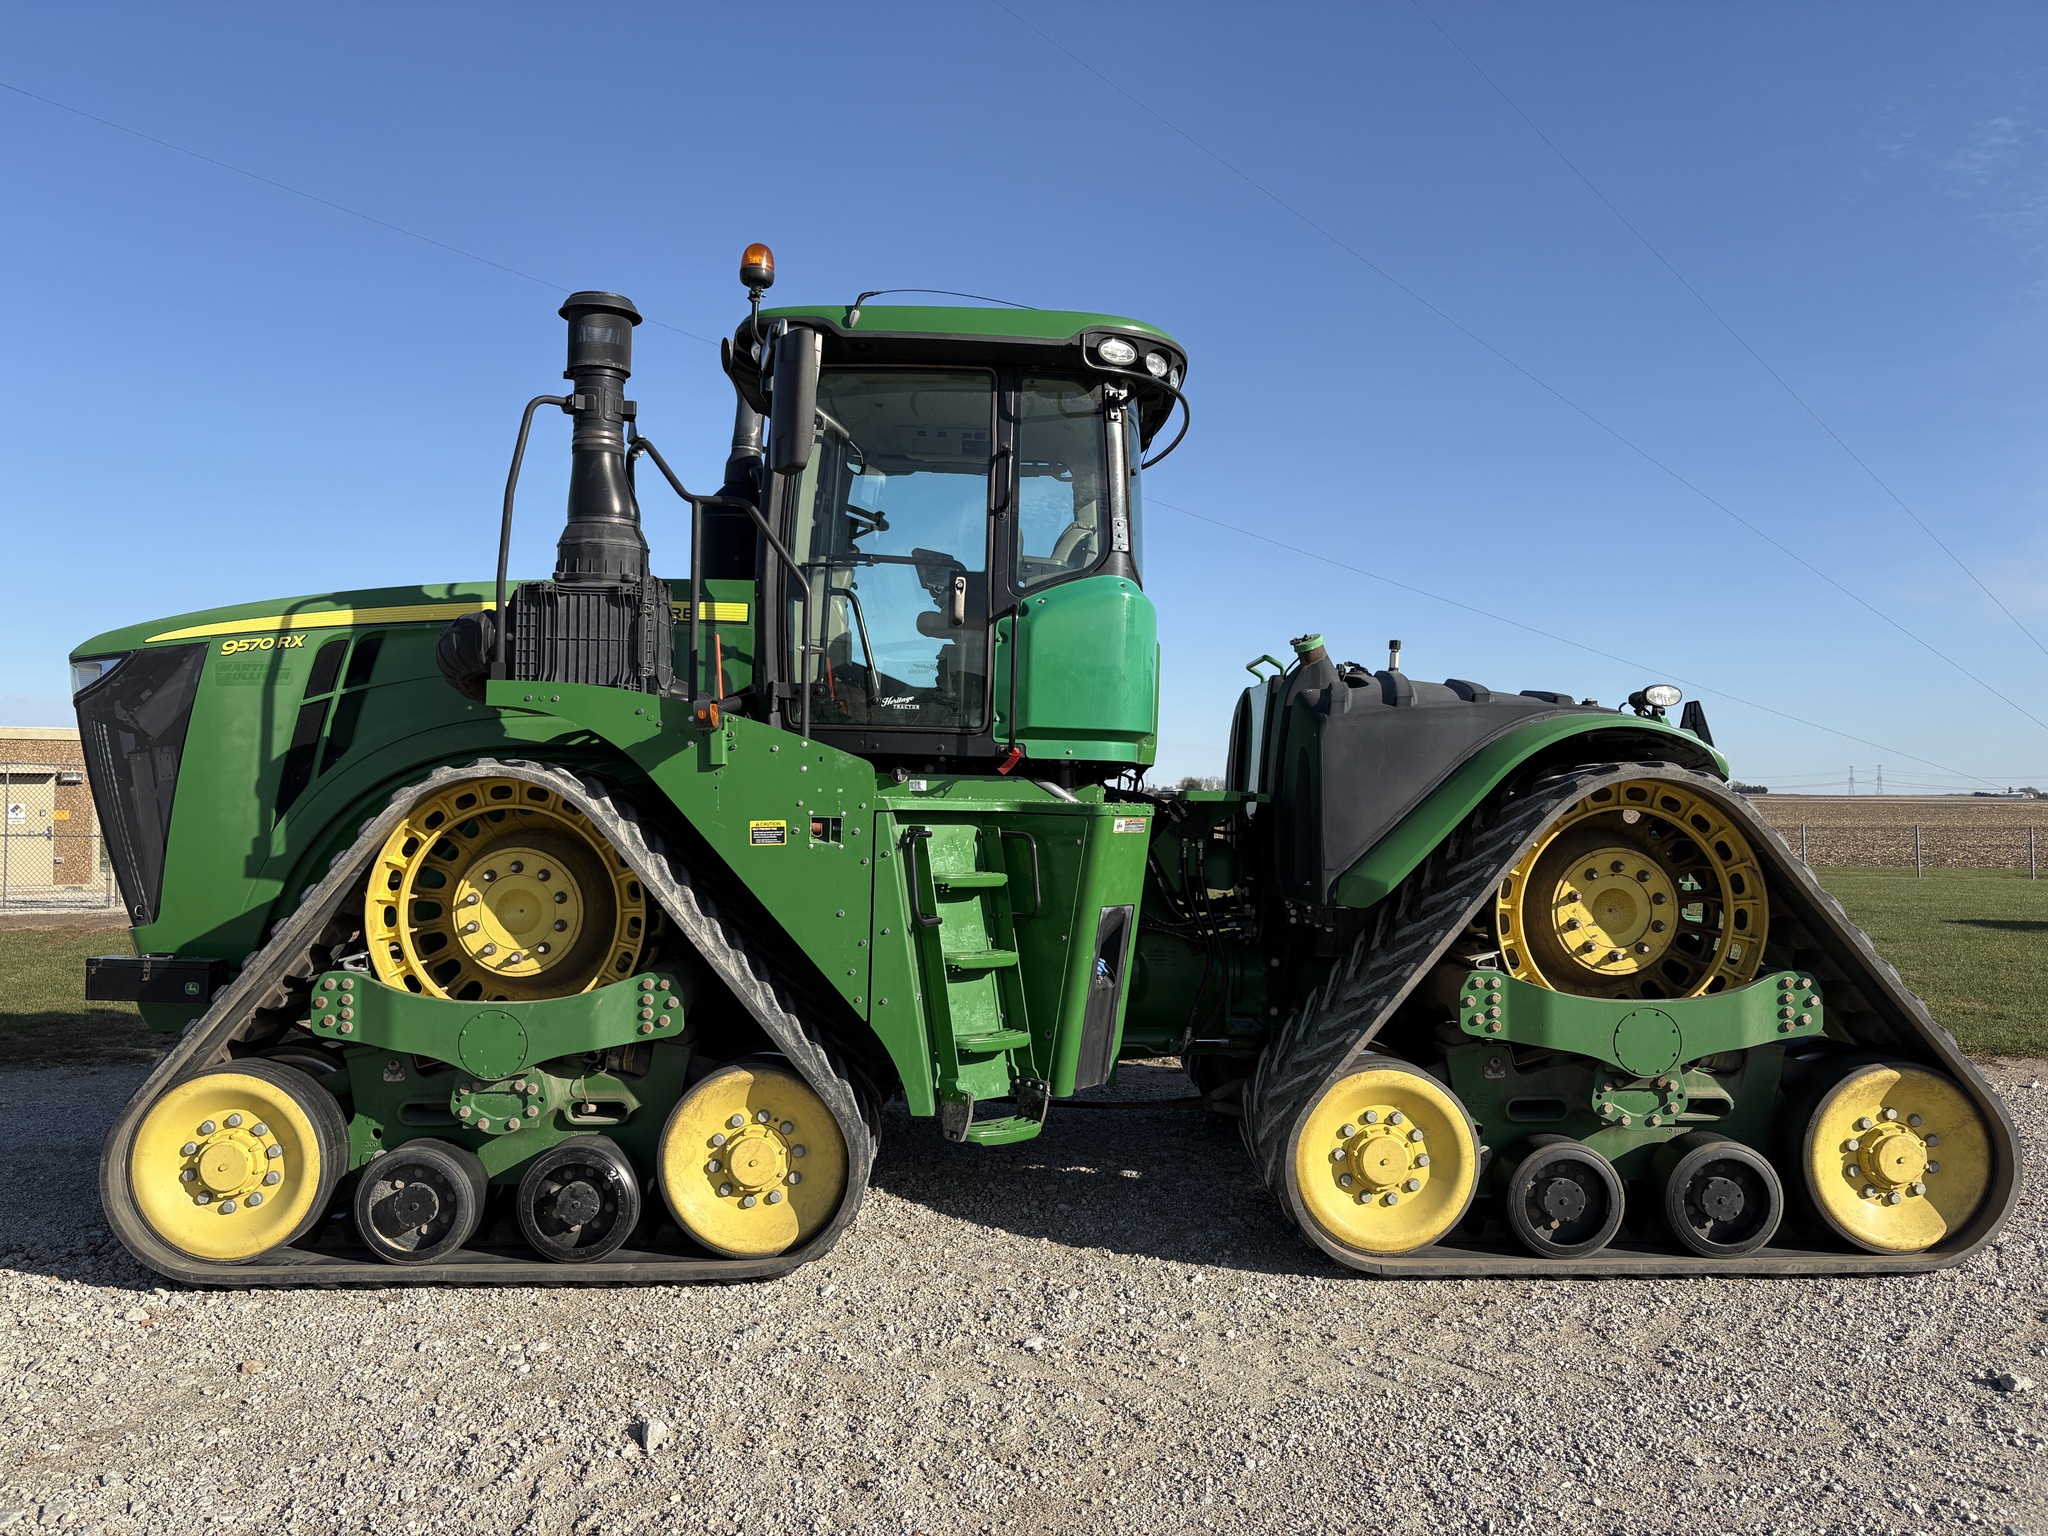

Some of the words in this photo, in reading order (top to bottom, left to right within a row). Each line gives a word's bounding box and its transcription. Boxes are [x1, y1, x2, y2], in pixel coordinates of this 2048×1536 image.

[220, 637, 275, 656] 9570
[277, 634, 308, 649] RX
[880, 696, 915, 707] Heritage
